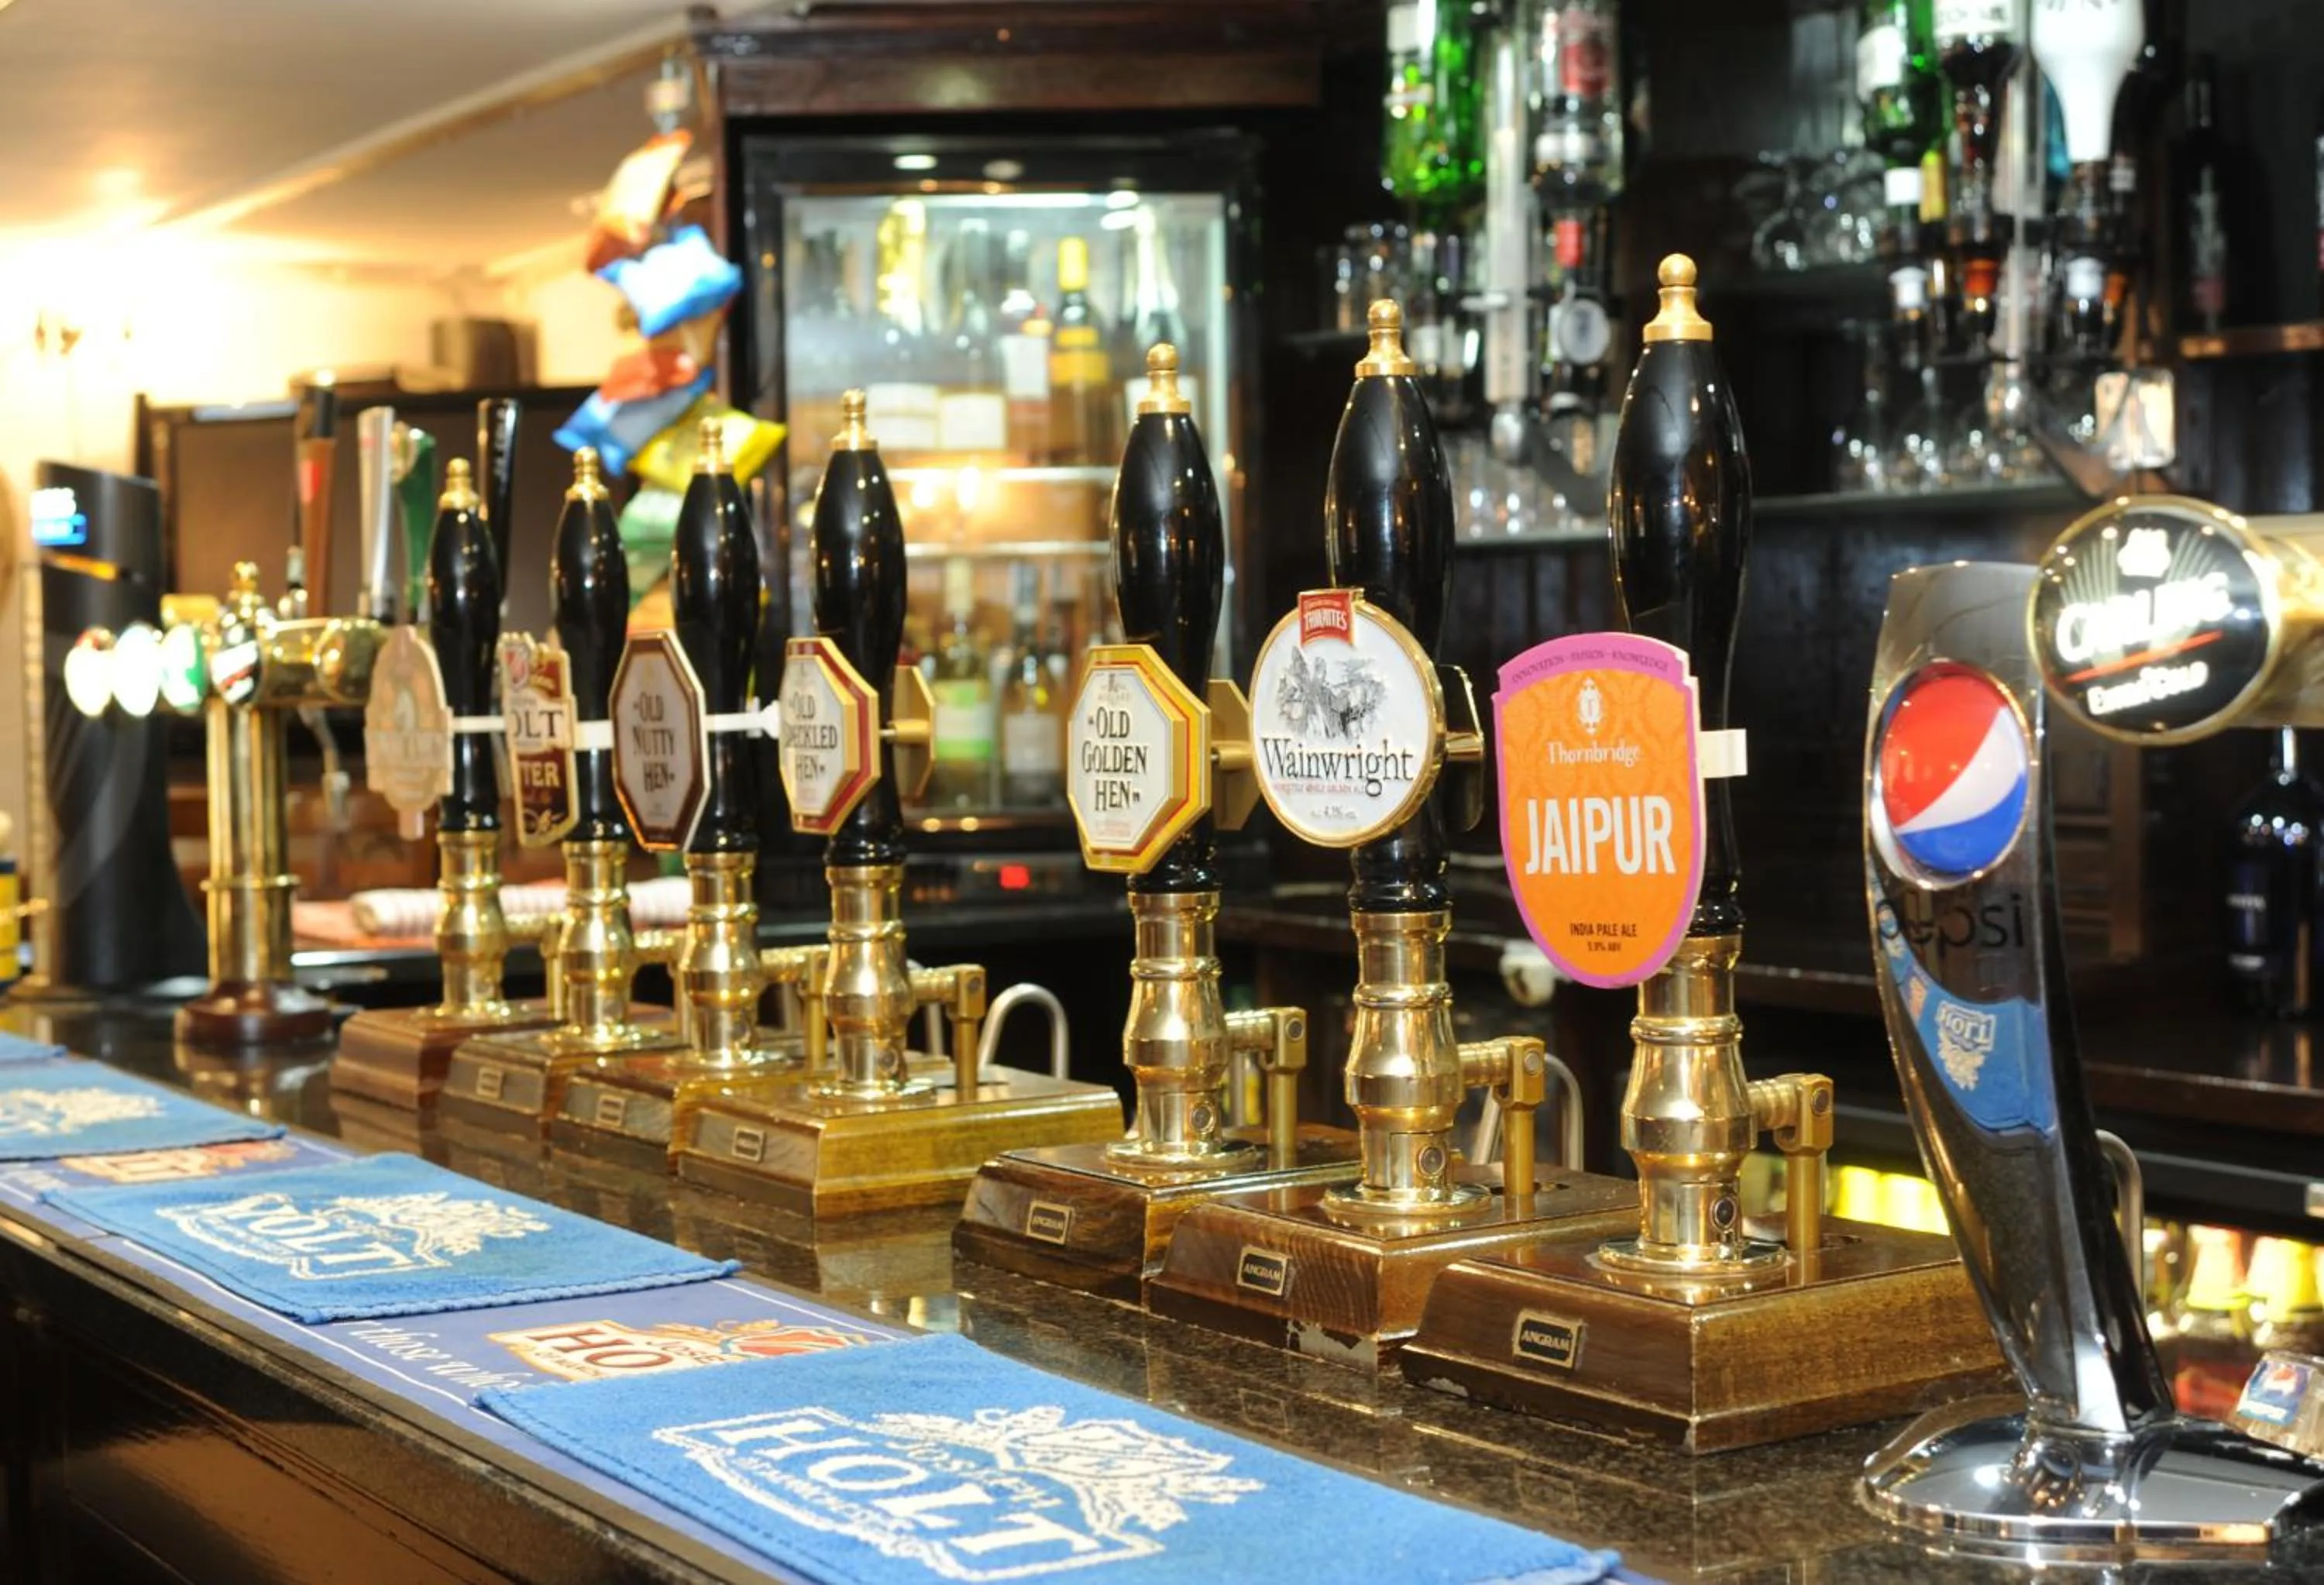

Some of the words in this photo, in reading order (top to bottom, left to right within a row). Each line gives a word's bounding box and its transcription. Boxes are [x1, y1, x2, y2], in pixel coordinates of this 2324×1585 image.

[632, 726, 675, 756] NUTTY
[1548, 740, 1641, 768] Thornbridge
[1081, 741, 1147, 774] GOLDEN
[1262, 737, 1413, 796] Wainwright
[1525, 795, 1677, 875] JAIPUR
[1570, 923, 1594, 936] INDIA
[1597, 923, 1619, 937] PALE
[1621, 923, 1637, 937] ALE
[1030, 1214, 1064, 1230] ANGRAM
[1243, 1263, 1282, 1281] ANGRAM
[527, 1327, 673, 1369] HO
[1521, 1328, 1571, 1352] ANGRAM
[713, 1419, 1102, 1554] HOLT
